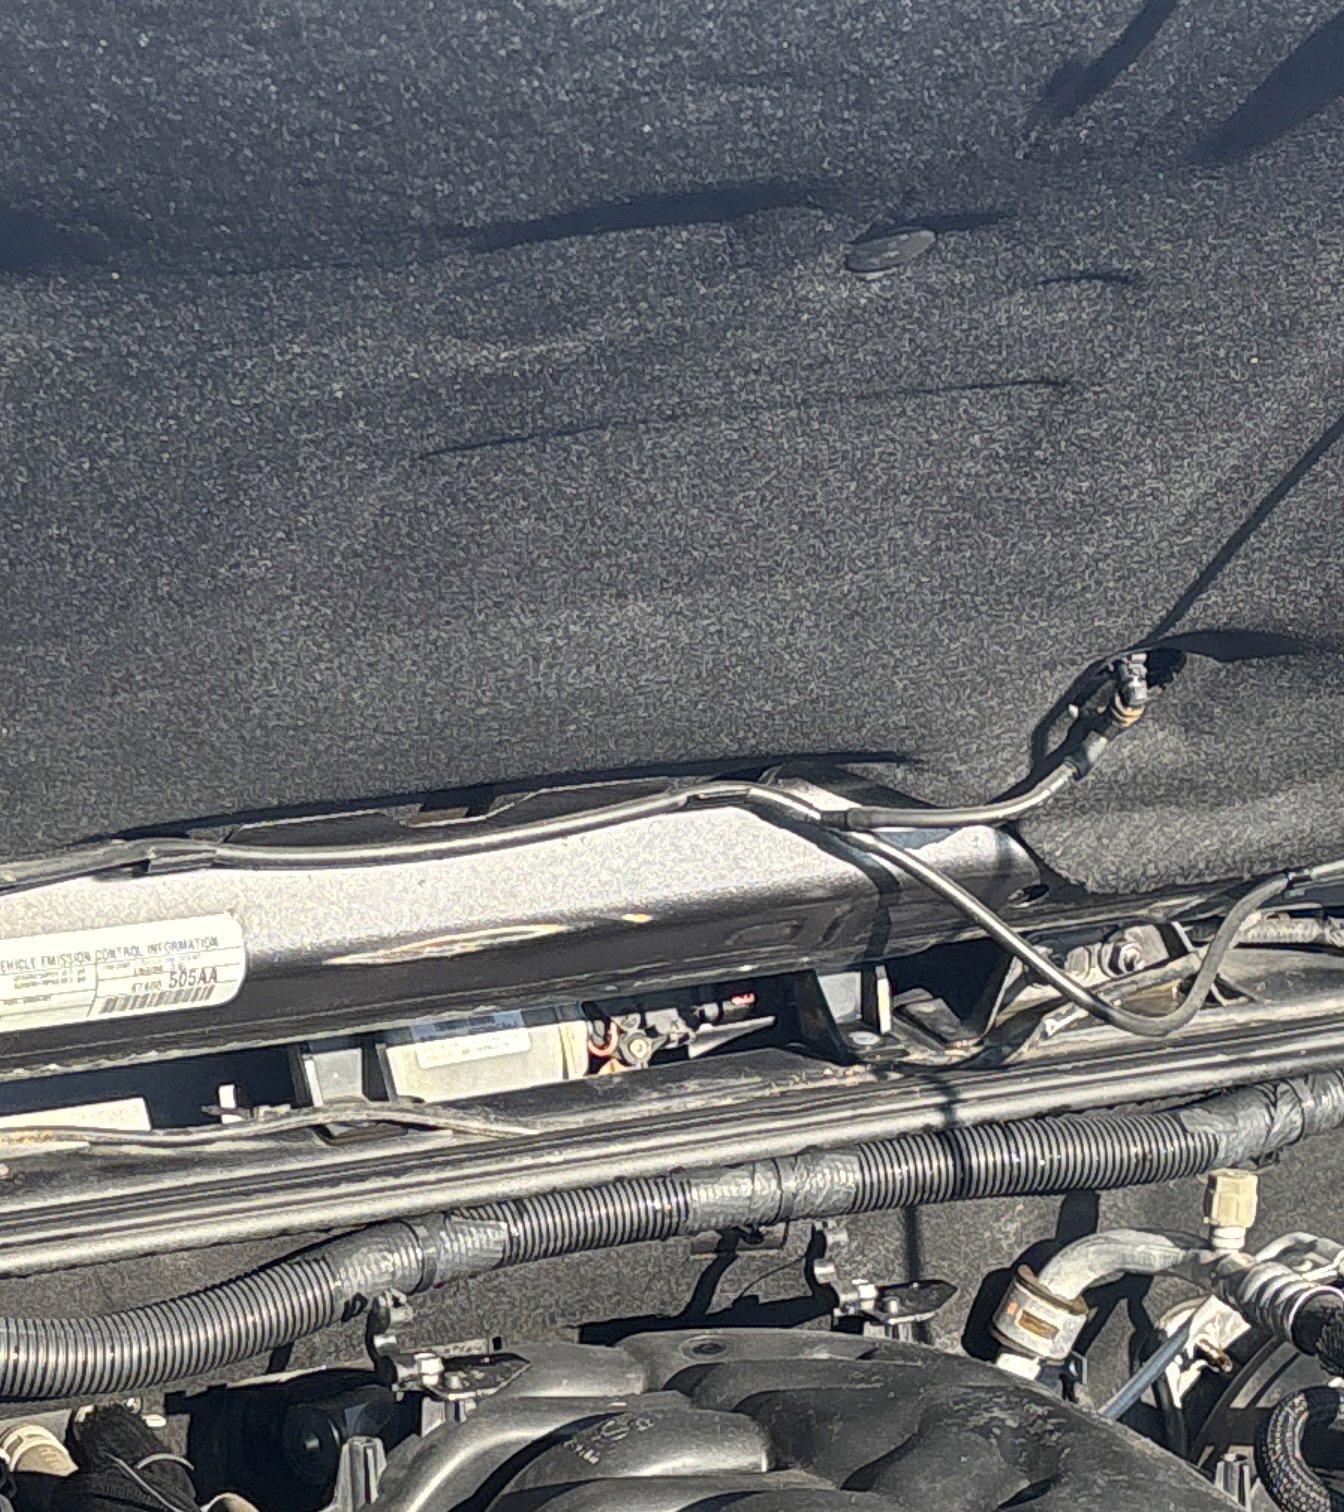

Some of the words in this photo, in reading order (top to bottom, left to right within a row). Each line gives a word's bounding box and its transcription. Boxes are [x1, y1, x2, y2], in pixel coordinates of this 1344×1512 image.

[41, 951, 92, 967] EMISSION
[97, 945, 143, 961] CONTROL
[147, 936, 218, 953] INFORMATION
